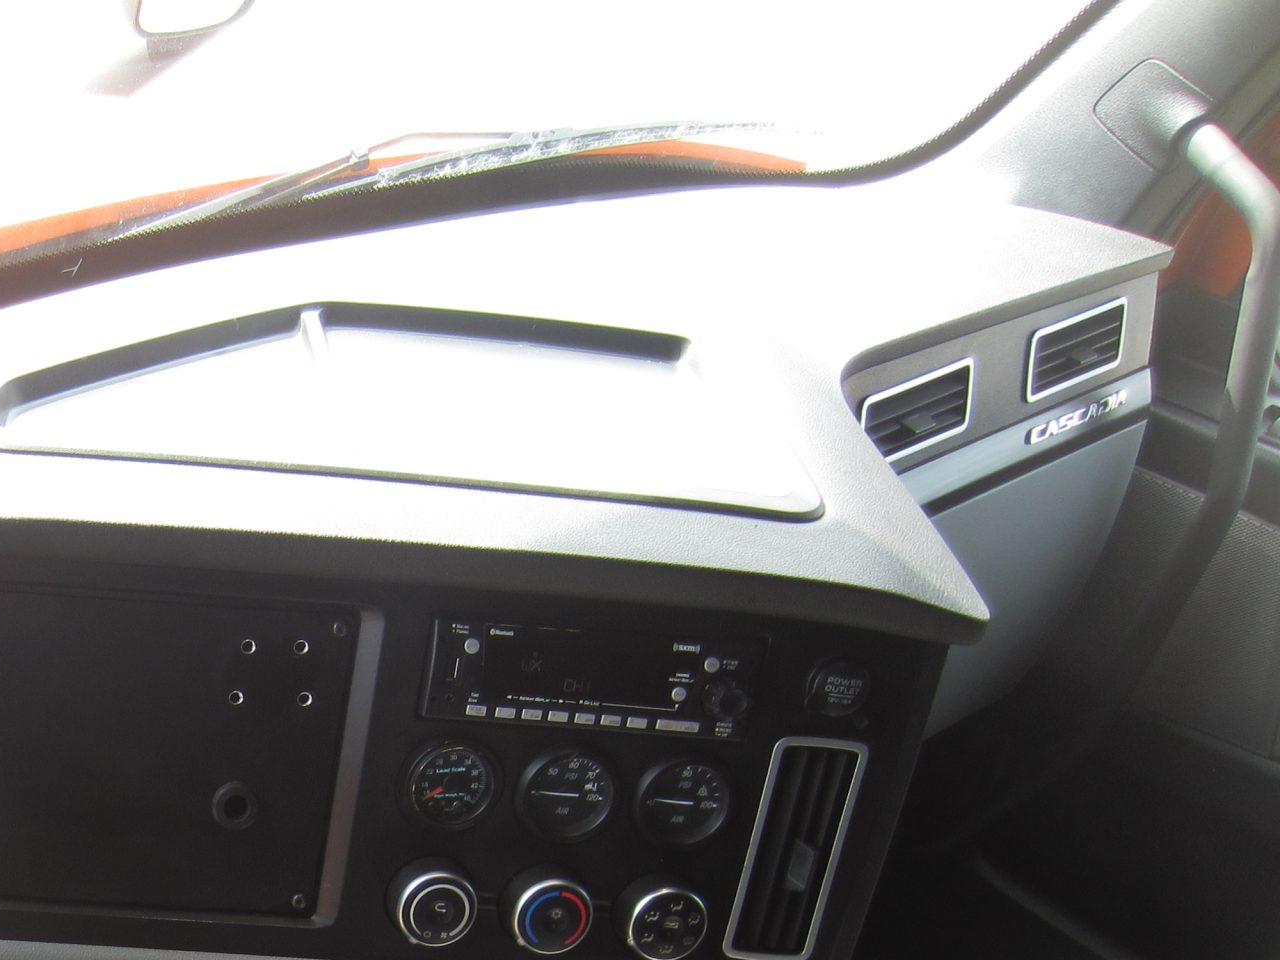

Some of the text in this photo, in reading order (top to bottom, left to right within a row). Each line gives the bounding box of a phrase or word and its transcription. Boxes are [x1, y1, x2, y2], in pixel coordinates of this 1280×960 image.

[827, 676, 862, 687] POWER
[824, 684, 860, 695] OUTLET
[569, 761, 579, 770] 60
[564, 772, 577, 781] PSI
[585, 771, 595, 780] 70
[700, 801, 713, 809] 100
[555, 806, 569, 815] AIR
[670, 815, 684, 823] AIR
